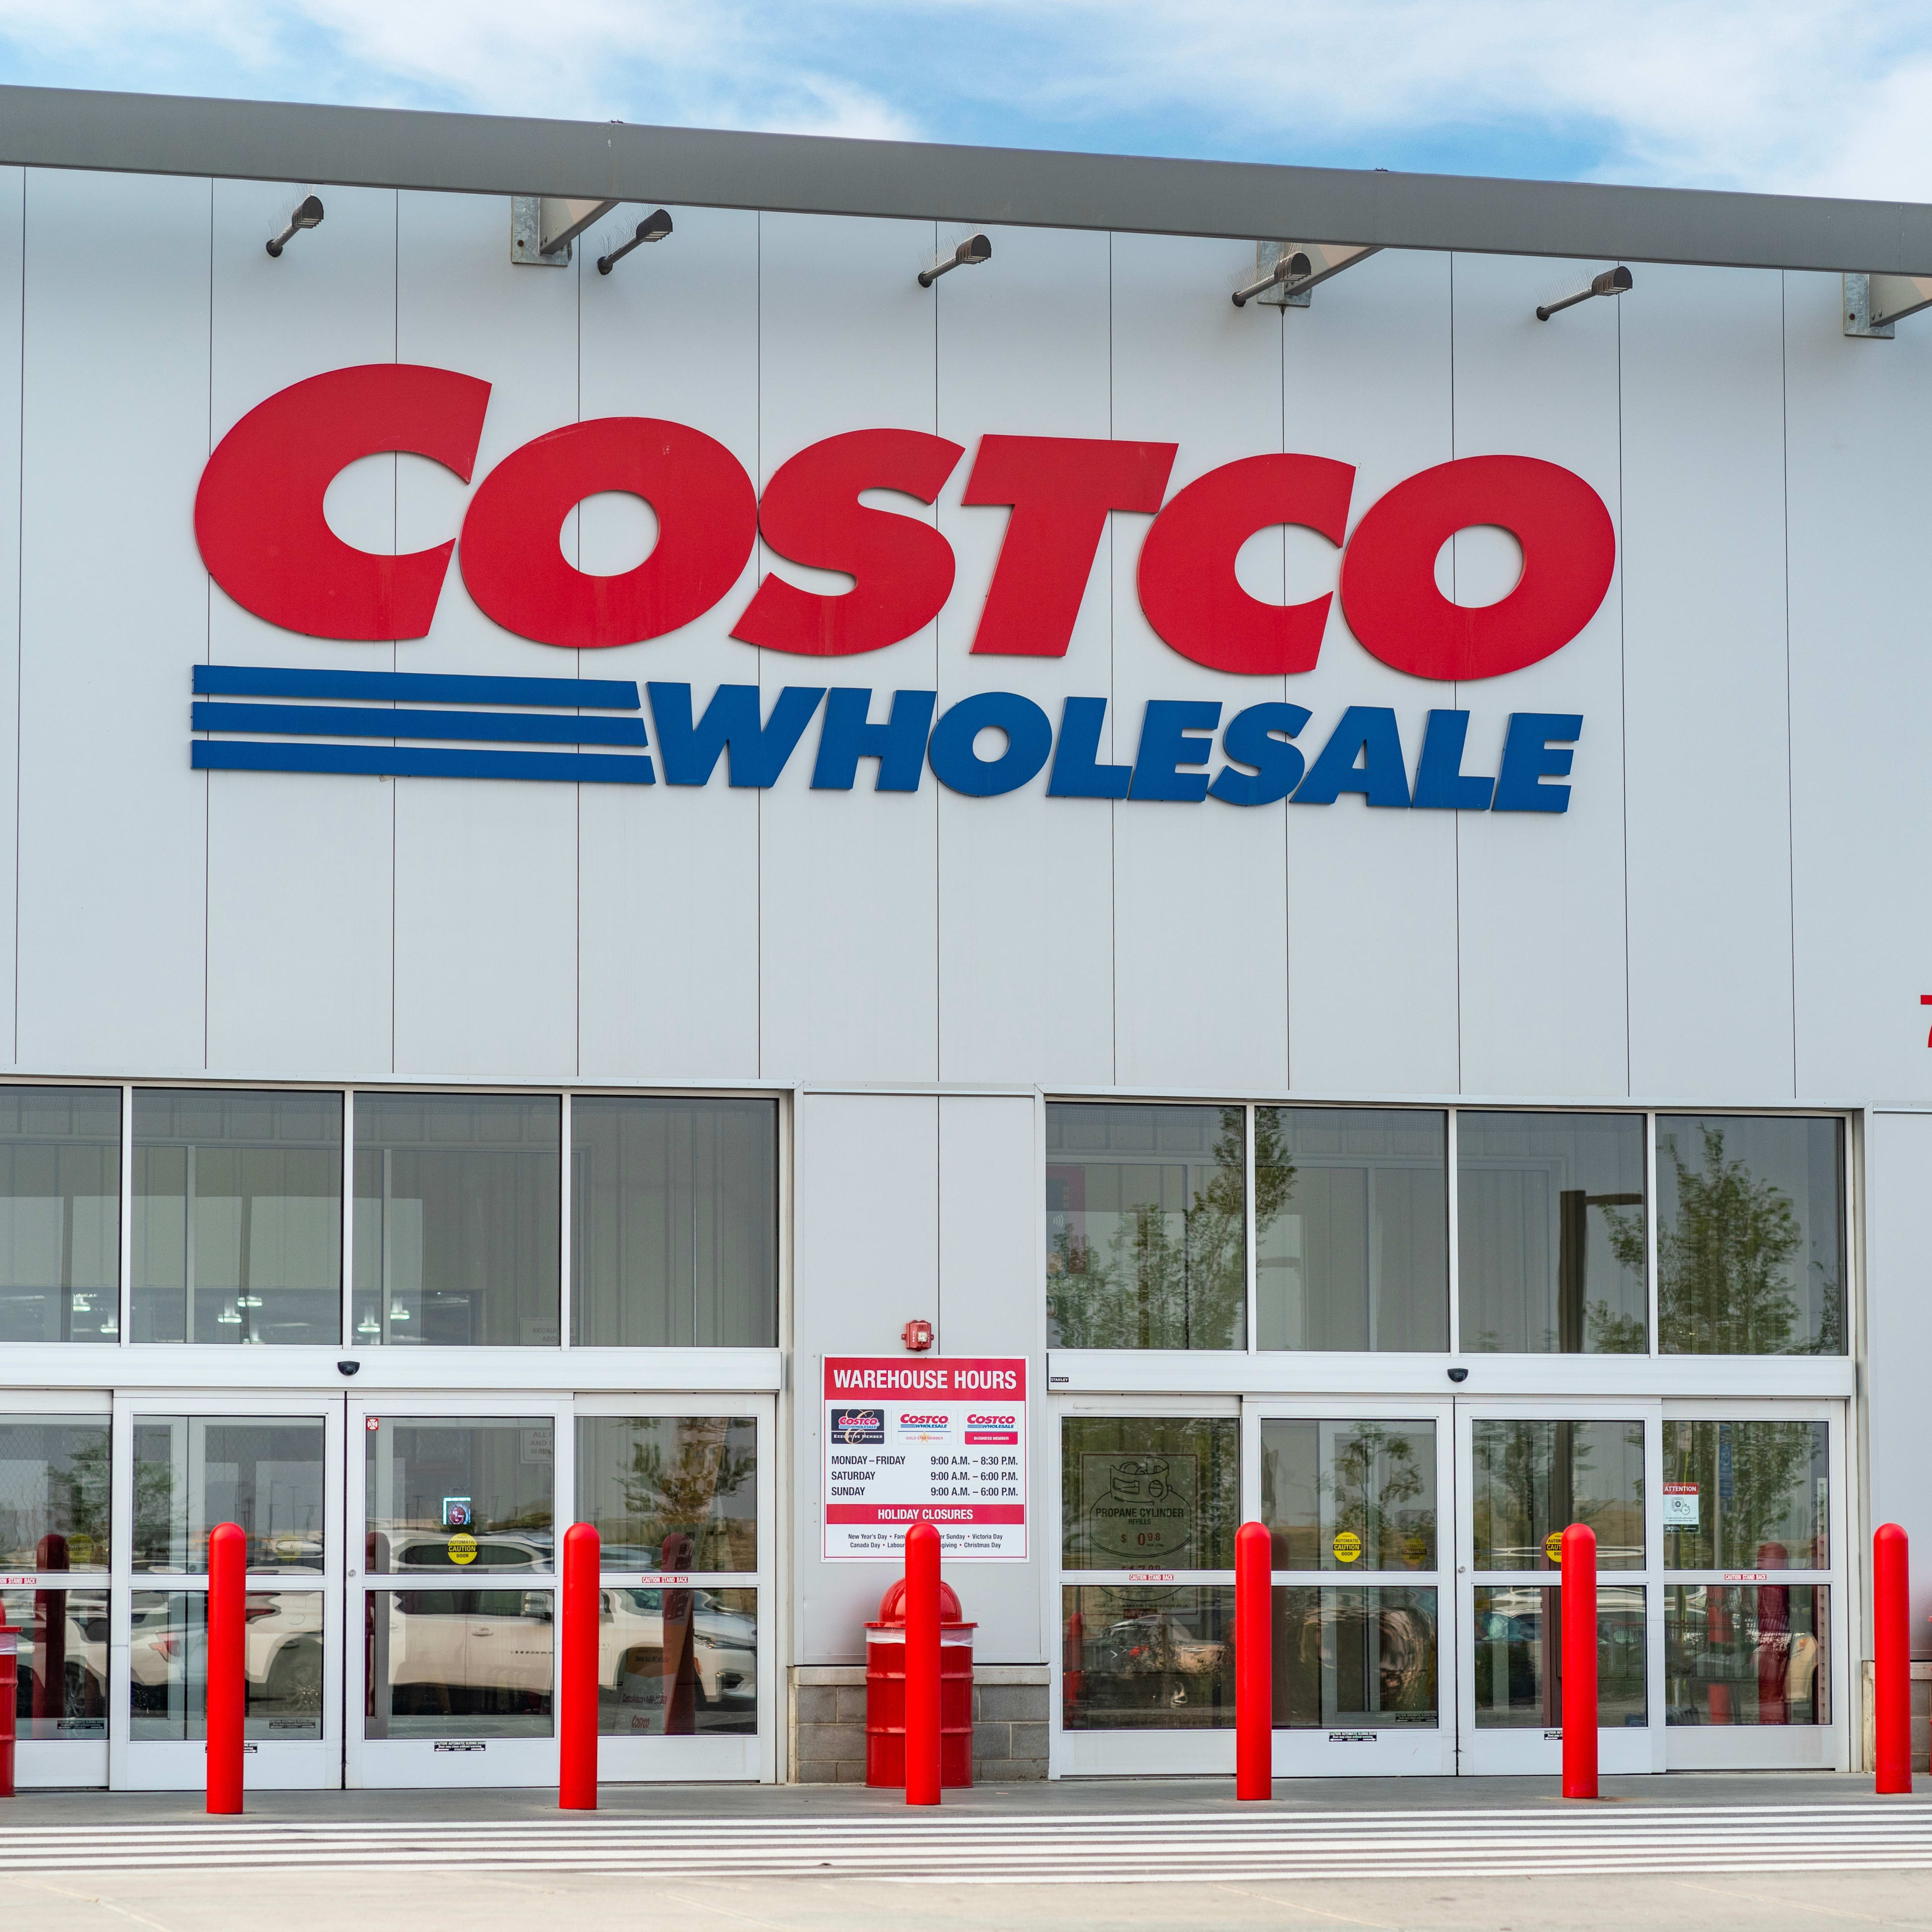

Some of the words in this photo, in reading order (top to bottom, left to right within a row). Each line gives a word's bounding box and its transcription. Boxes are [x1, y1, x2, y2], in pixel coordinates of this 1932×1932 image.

[195, 363, 1615, 681] COSTCO
[648, 682, 1583, 813] WHOLESALE
[833, 1370, 948, 1389] WAREHOUSE
[955, 1371, 1016, 1389] HOURS
[839, 1417, 877, 1425] COSTCO
[900, 1414, 948, 1424] COSTCO
[967, 1414, 1015, 1424] COSTCO
[832, 1456, 868, 1465] MONDAY
[876, 1456, 905, 1465] FRIDAY
[931, 1457, 948, 1465] 9:00
[951, 1457, 970, 1465] A.M.
[981, 1457, 999, 1465] 8:30
[1002, 1457, 1018, 1465] P.M.
[832, 1472, 875, 1480] SATURDAY
[931, 1472, 948, 1481] 9:00
[951, 1472, 970, 1481] A.M.
[981, 1472, 999, 1481] 6:00
[1002, 1472, 1018, 1481] P.M.
[832, 1487, 865, 1496] SUNDAY
[931, 1488, 948, 1496] 9:00
[951, 1488, 970, 1496] A.M.
[981, 1488, 999, 1496] 6:00
[1002, 1488, 1018, 1496] P.M.
[878, 1509, 919, 1519] HOLIDAY
[922, 1509, 973, 1519] CLOSURES
[1096, 1508, 1137, 1517] PROPANE
[1140, 1508, 1183, 1517] CYLINDER
